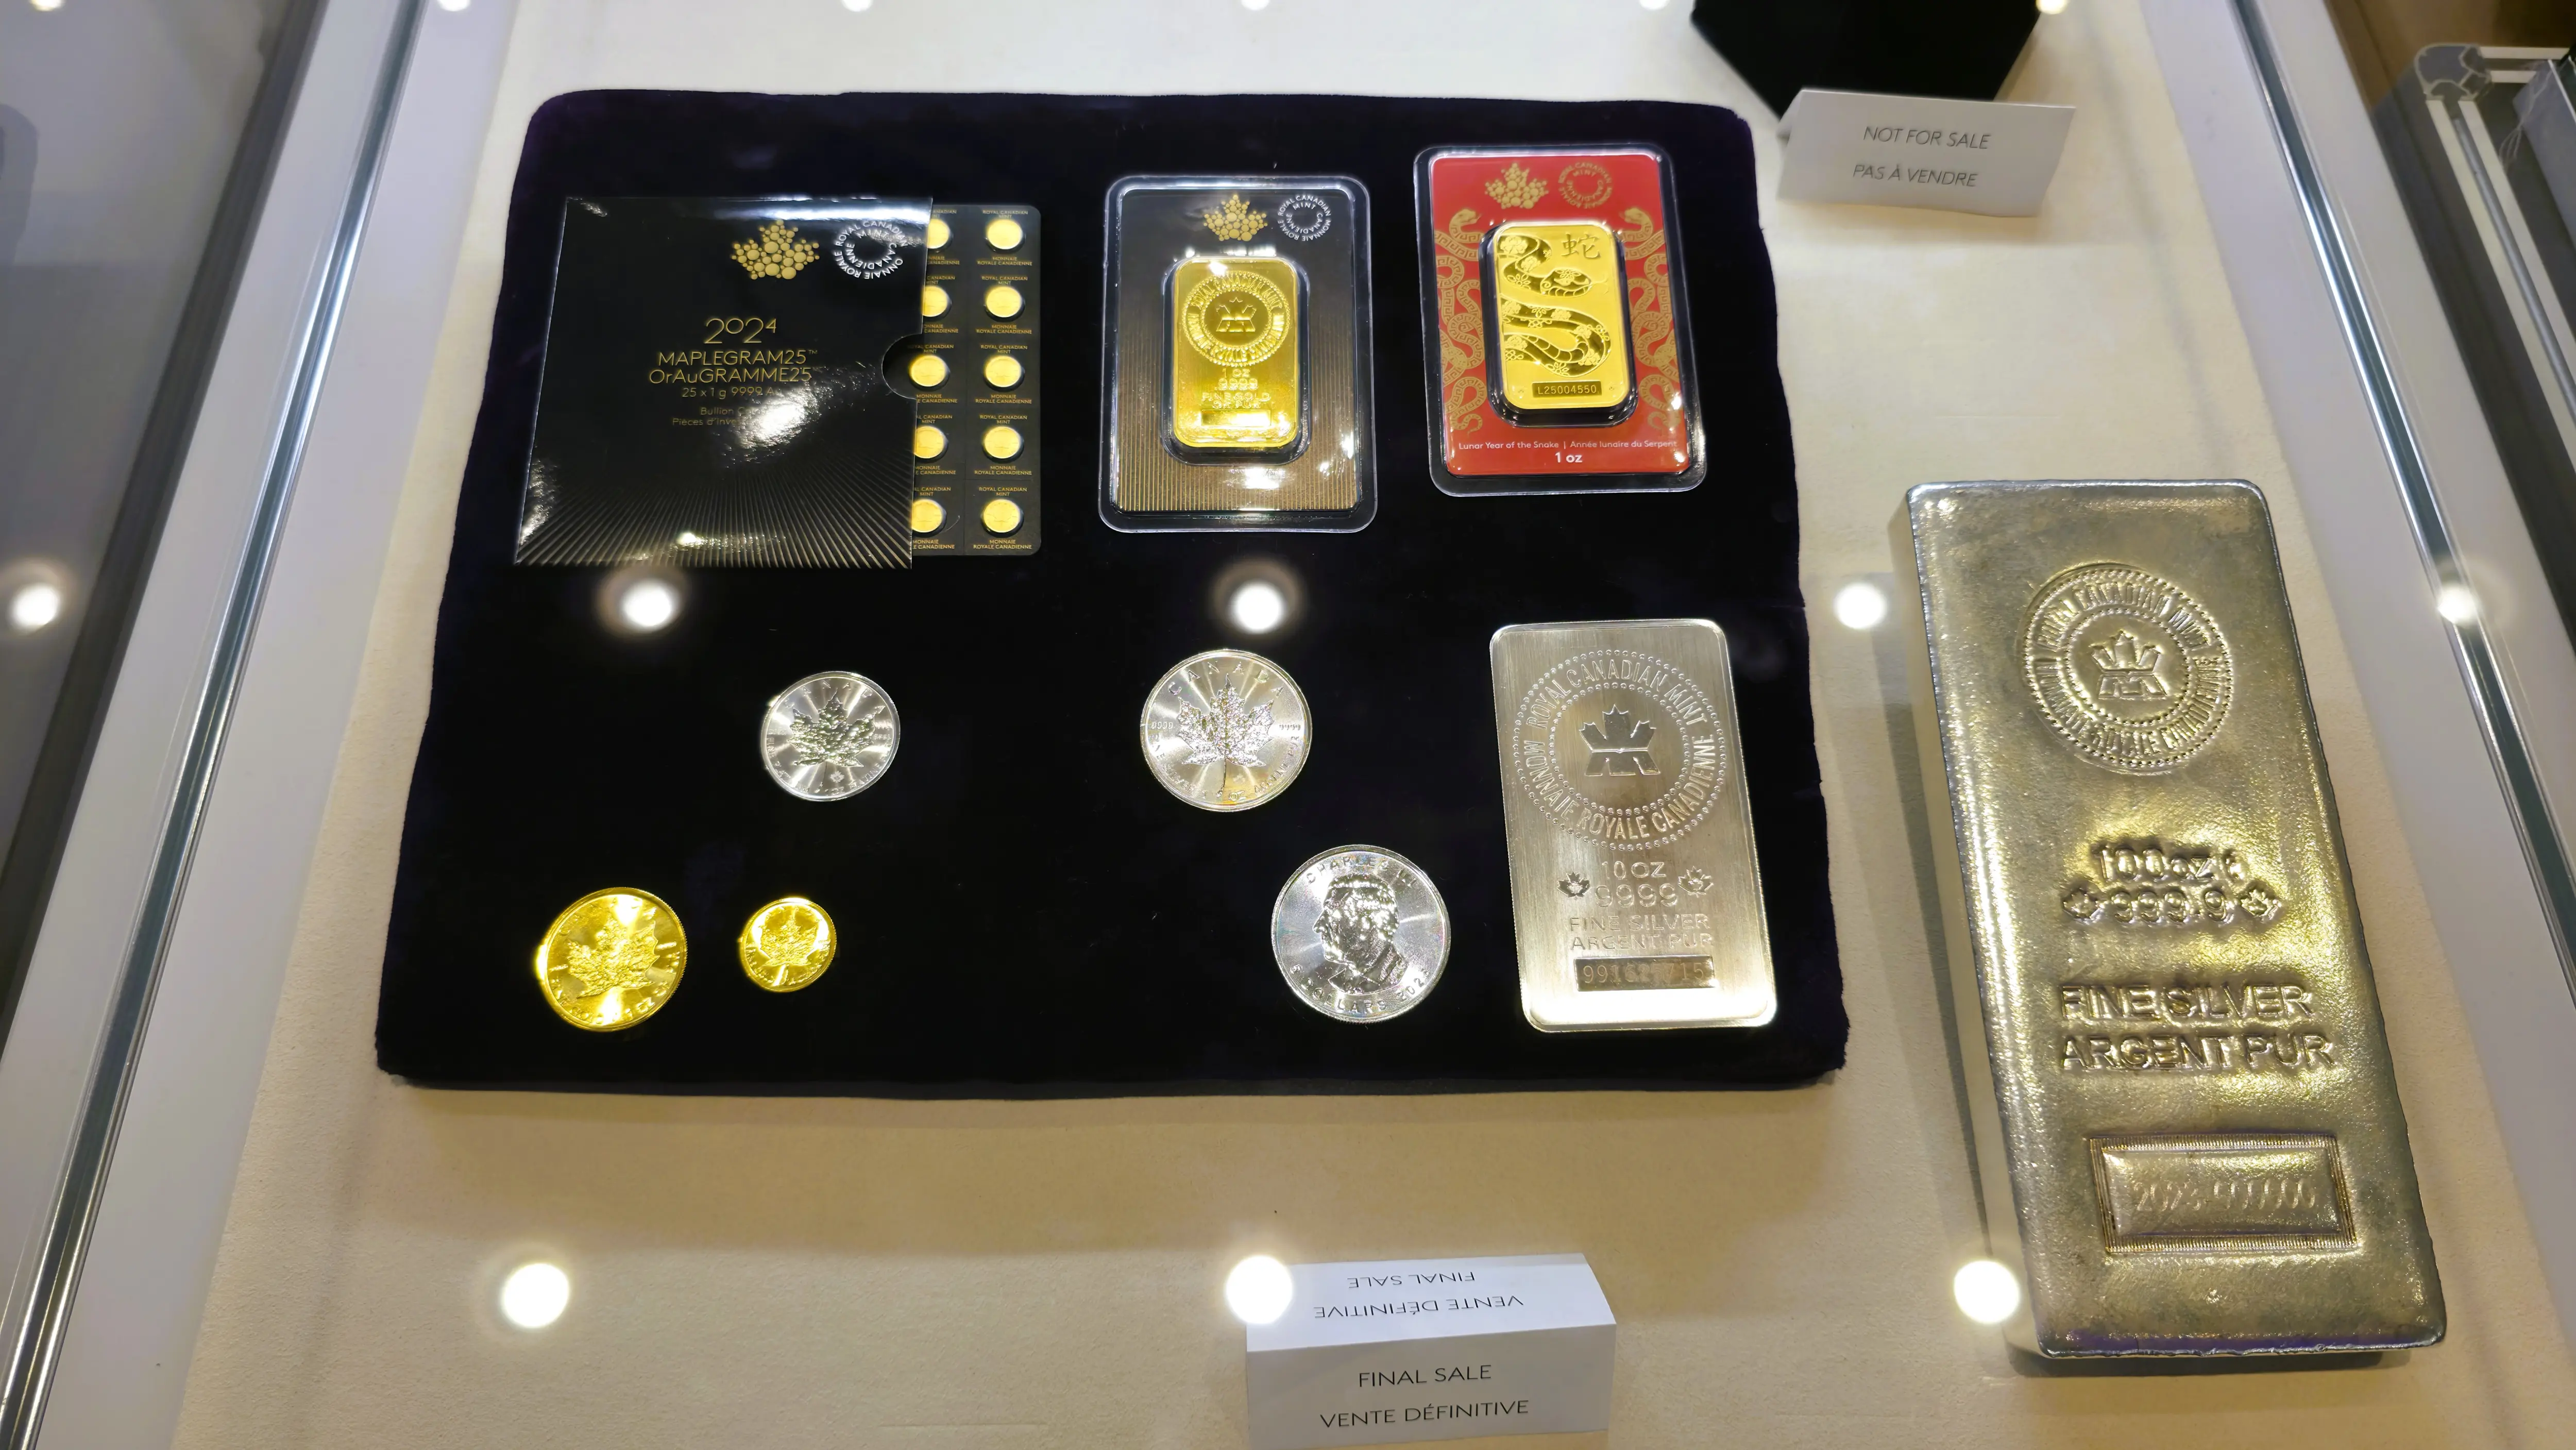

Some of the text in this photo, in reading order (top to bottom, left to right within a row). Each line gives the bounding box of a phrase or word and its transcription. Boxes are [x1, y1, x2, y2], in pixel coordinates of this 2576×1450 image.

[1863, 126, 1991, 149] NOT FOR SALE
[1853, 164, 1978, 187] PAS À VENDRE
[1278, 198, 1295, 216] ROYAL
[1296, 195, 1331, 216] CANADIAN
[835, 221, 908, 246] ROYAL CANADIAN MINT
[1278, 213, 1331, 241] MONNAIE ROYALE CANADIENNE
[1561, 233, 1601, 259] 蛇
[835, 243, 903, 279] ONNAIE ROYALE CANADIENNE
[704, 318, 777, 344] 2024
[1222, 368, 1250, 378] 1 OZ
[682, 387, 697, 397] 25
[710, 387, 715, 396] 1
[719, 389, 726, 400] g
[732, 387, 762, 396] 9999
[1234, 393, 1271, 402] GOLD
[1538, 384, 1597, 395] L25004550
[673, 418, 703, 426] Pièces
[1645, 441, 1677, 449] Serpent
[1555, 452, 1583, 463] 1 oz
[1526, 659, 1707, 730] ROYAL CANADIAN MINT
[1523, 734, 1716, 840] MONNAIE ROYALE CANADIENNE
[1601, 861, 1666, 880] 10 OZ
[1595, 883, 1677, 908] 9999
[1570, 914, 1711, 932] FINE SILVER
[1571, 933, 1714, 950] ARGENT PUR
[1300, 976, 1386, 1014] DOLLARS
[2060, 983, 2314, 1019] FINE SILVER
[2061, 1032, 2336, 1068] ARGENT PUR
[1347, 1271, 1475, 1288] FINAL SALE
[1314, 1295, 1523, 1319] VENTE DÉFINITIVE
[1359, 1364, 1492, 1388] FINAL SALE
[1319, 1400, 1529, 1428] VENTE DÉFINITIVE
